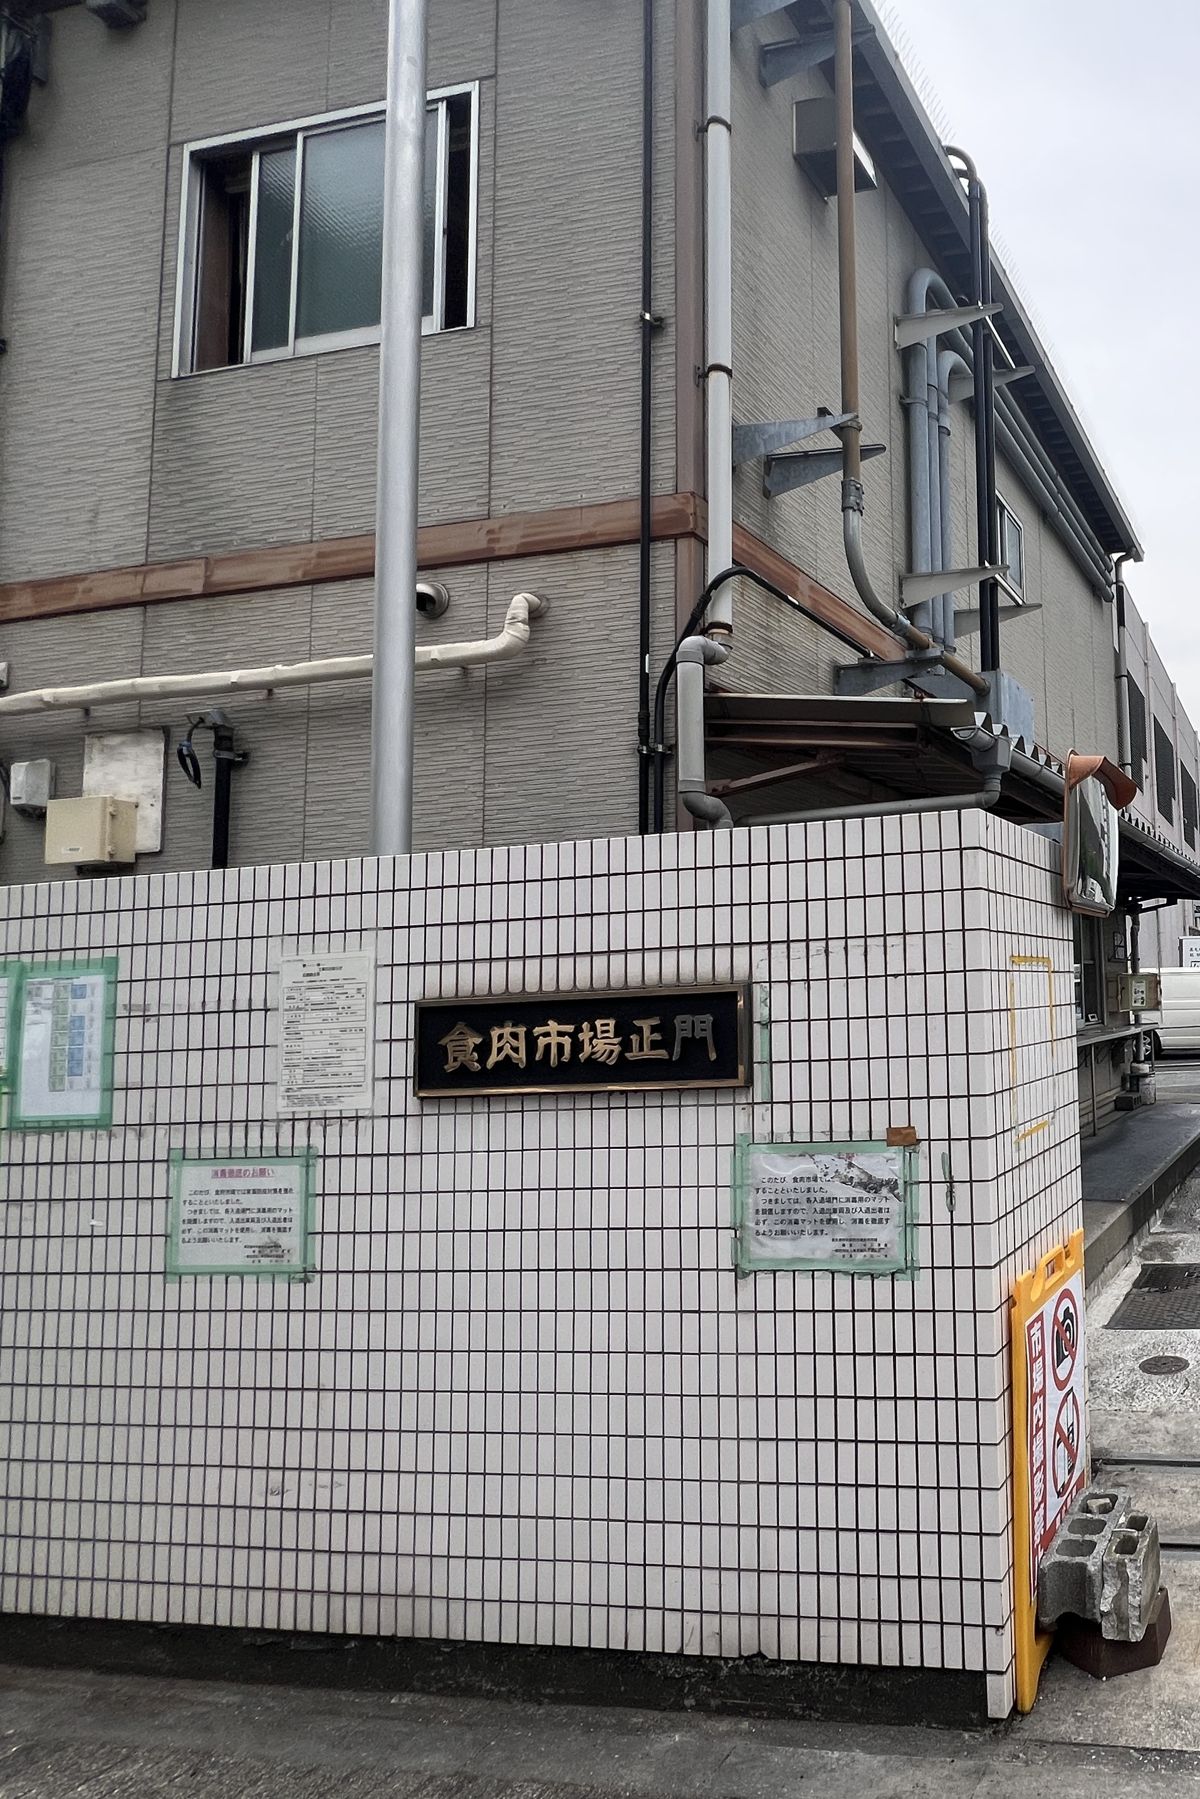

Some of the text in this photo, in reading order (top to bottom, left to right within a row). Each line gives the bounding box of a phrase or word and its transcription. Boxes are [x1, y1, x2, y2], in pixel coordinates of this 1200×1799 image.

[437, 1014, 717, 1072] 食肉市場正門
